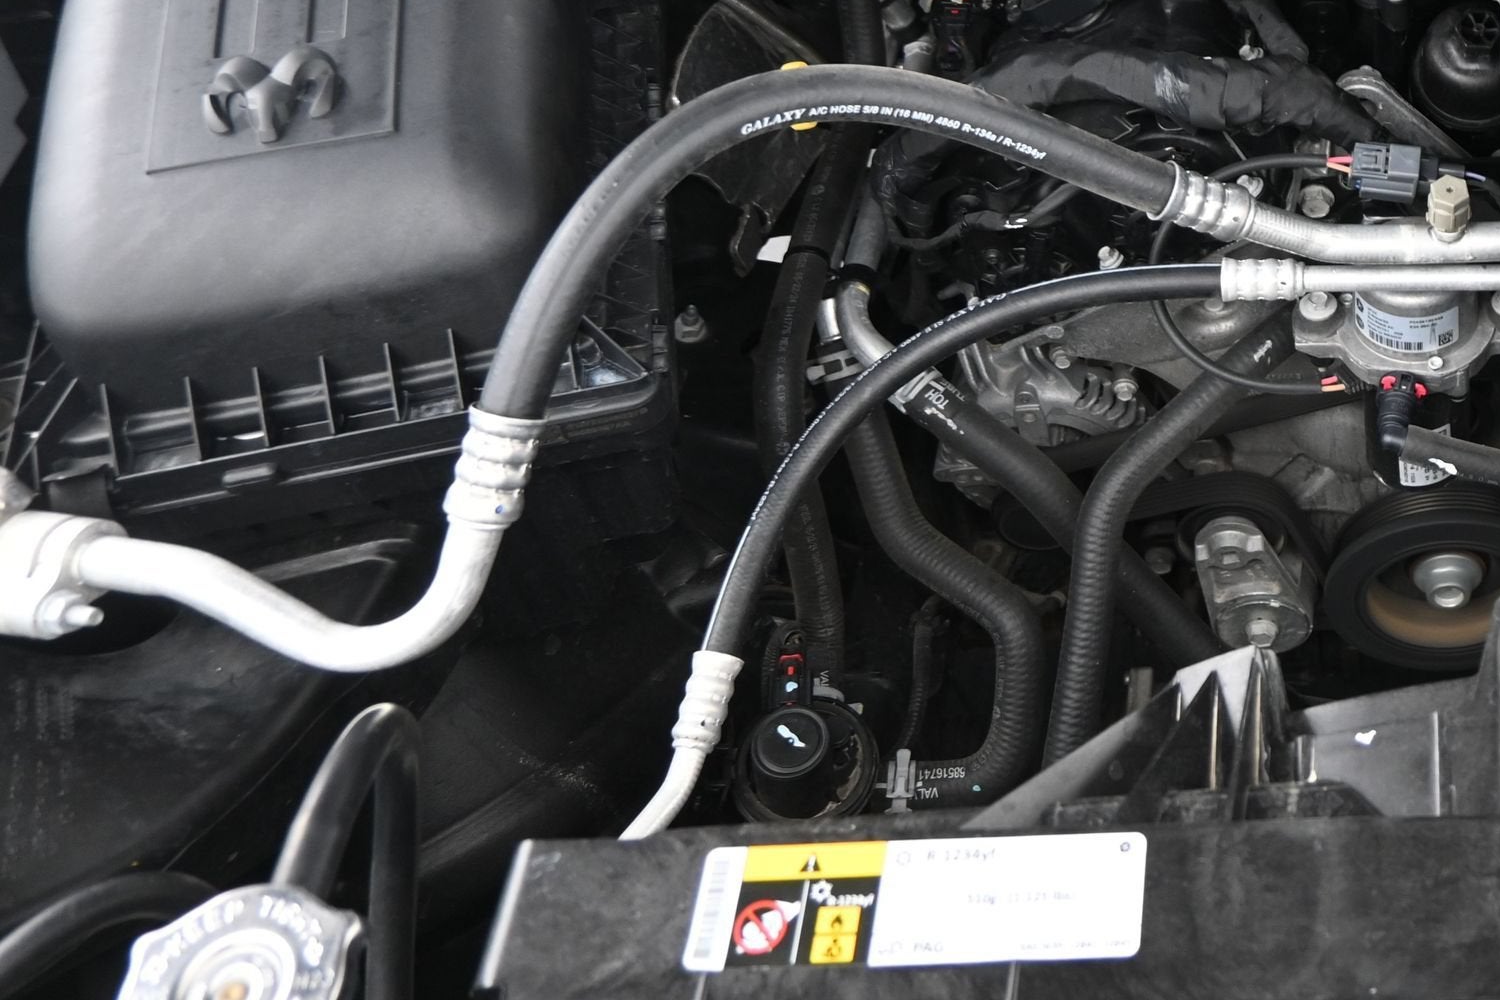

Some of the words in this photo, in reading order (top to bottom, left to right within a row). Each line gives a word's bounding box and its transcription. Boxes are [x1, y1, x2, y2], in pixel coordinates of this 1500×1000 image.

[740, 108, 806, 135] GALAXY
[809, 106, 827, 116] A/C
[830, 105, 861, 114] HOSE
[863, 105, 879, 114] 5/8
[881, 106, 893, 116] IN
[911, 111, 934, 124] MM)
[962, 123, 997, 142] R-134a
[1002, 137, 1047, 160] R-1234yf
